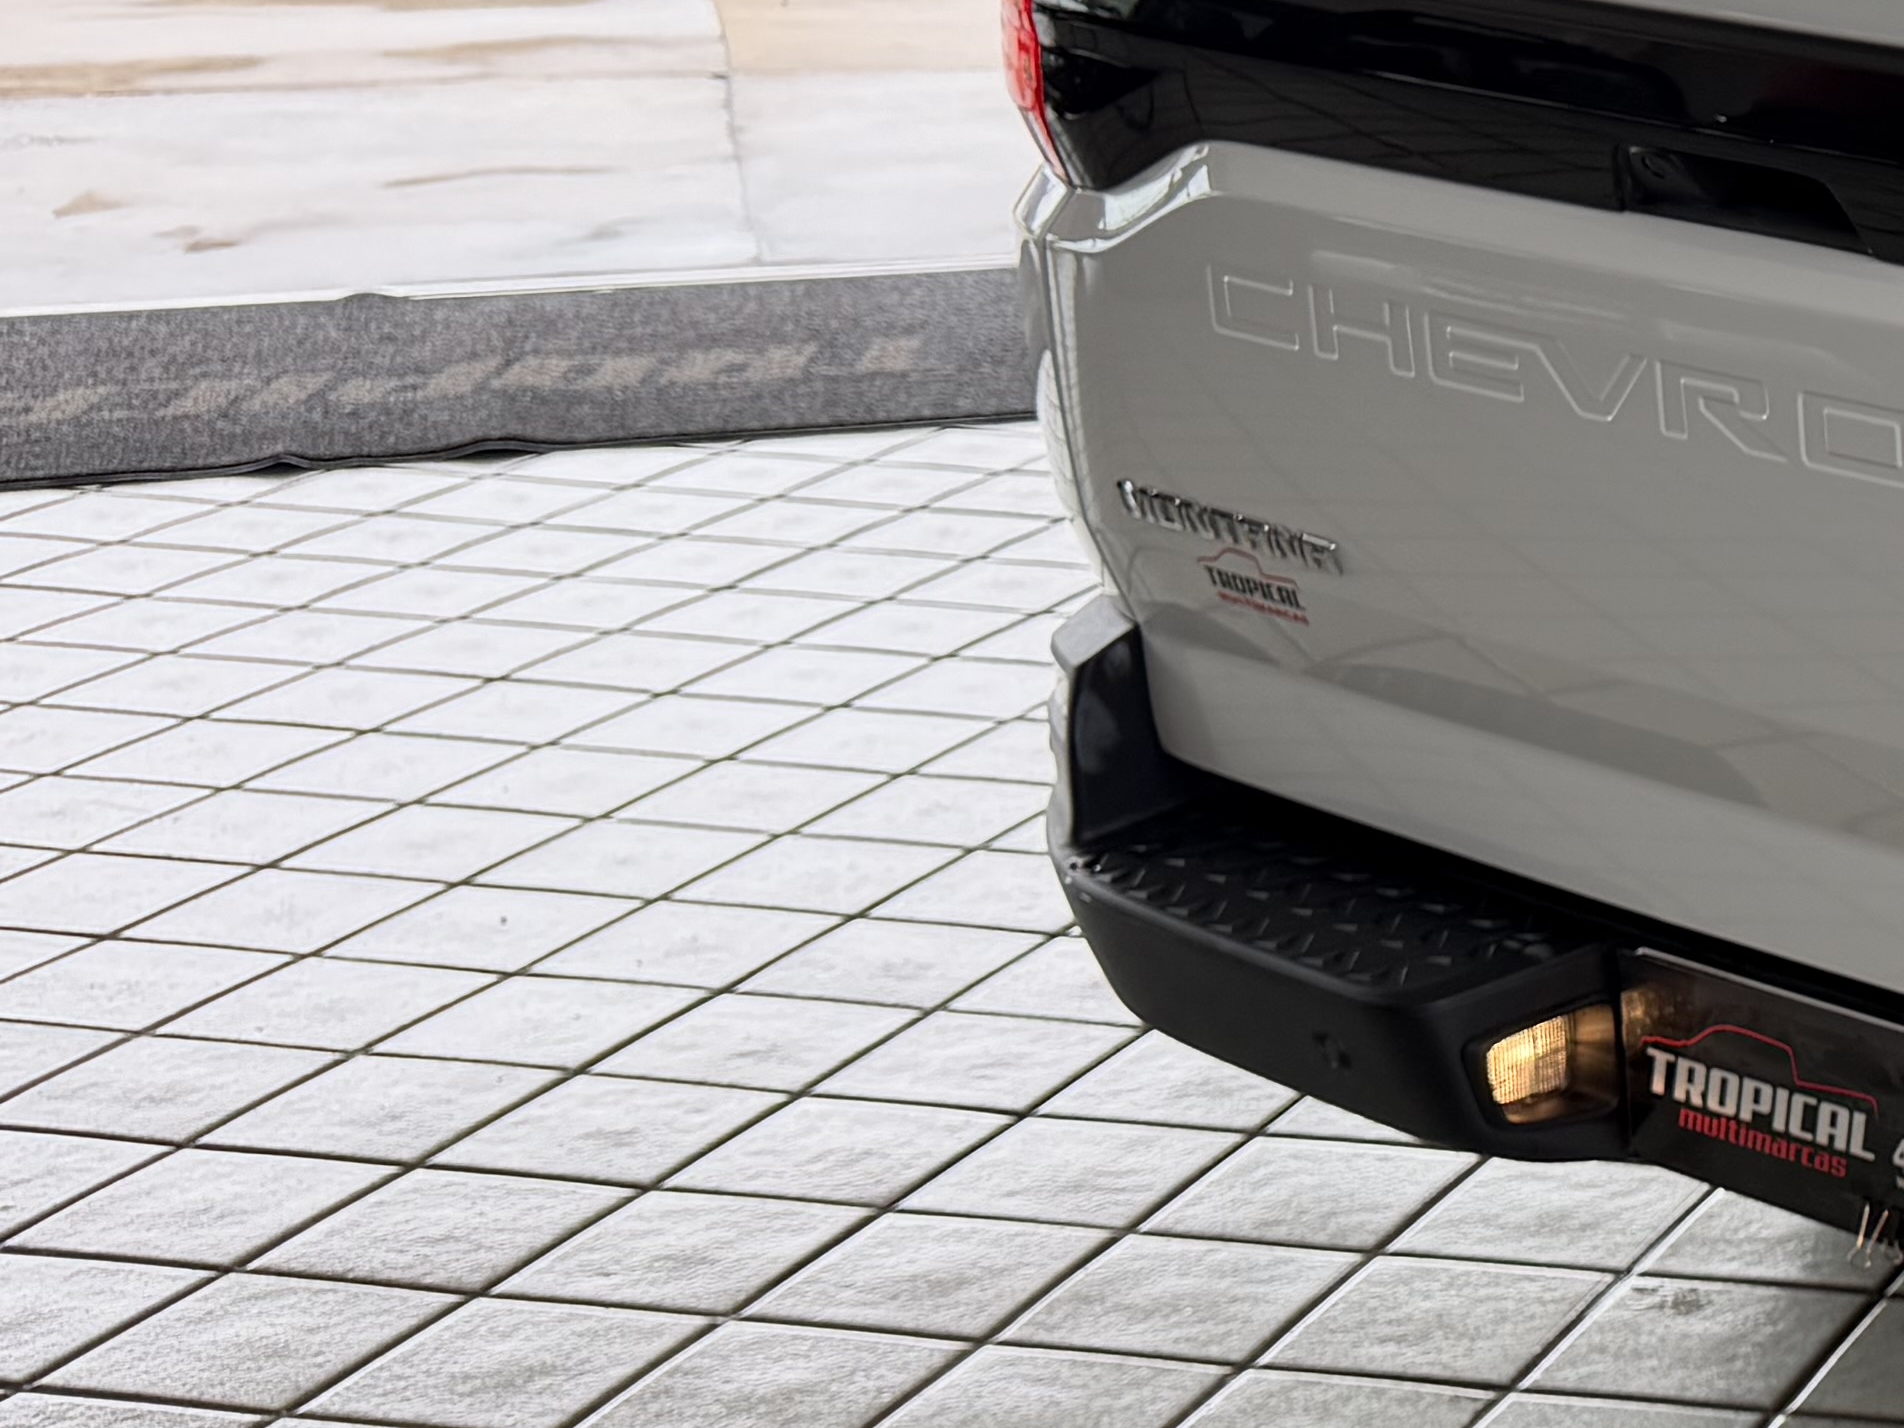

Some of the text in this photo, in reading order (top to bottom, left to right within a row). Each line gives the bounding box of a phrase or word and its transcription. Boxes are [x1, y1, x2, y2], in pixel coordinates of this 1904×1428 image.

[1203, 564, 1307, 611] TROPICAL
[1645, 1046, 1876, 1162] TROPICAL
[1678, 1107, 1848, 1179] multimarcas
